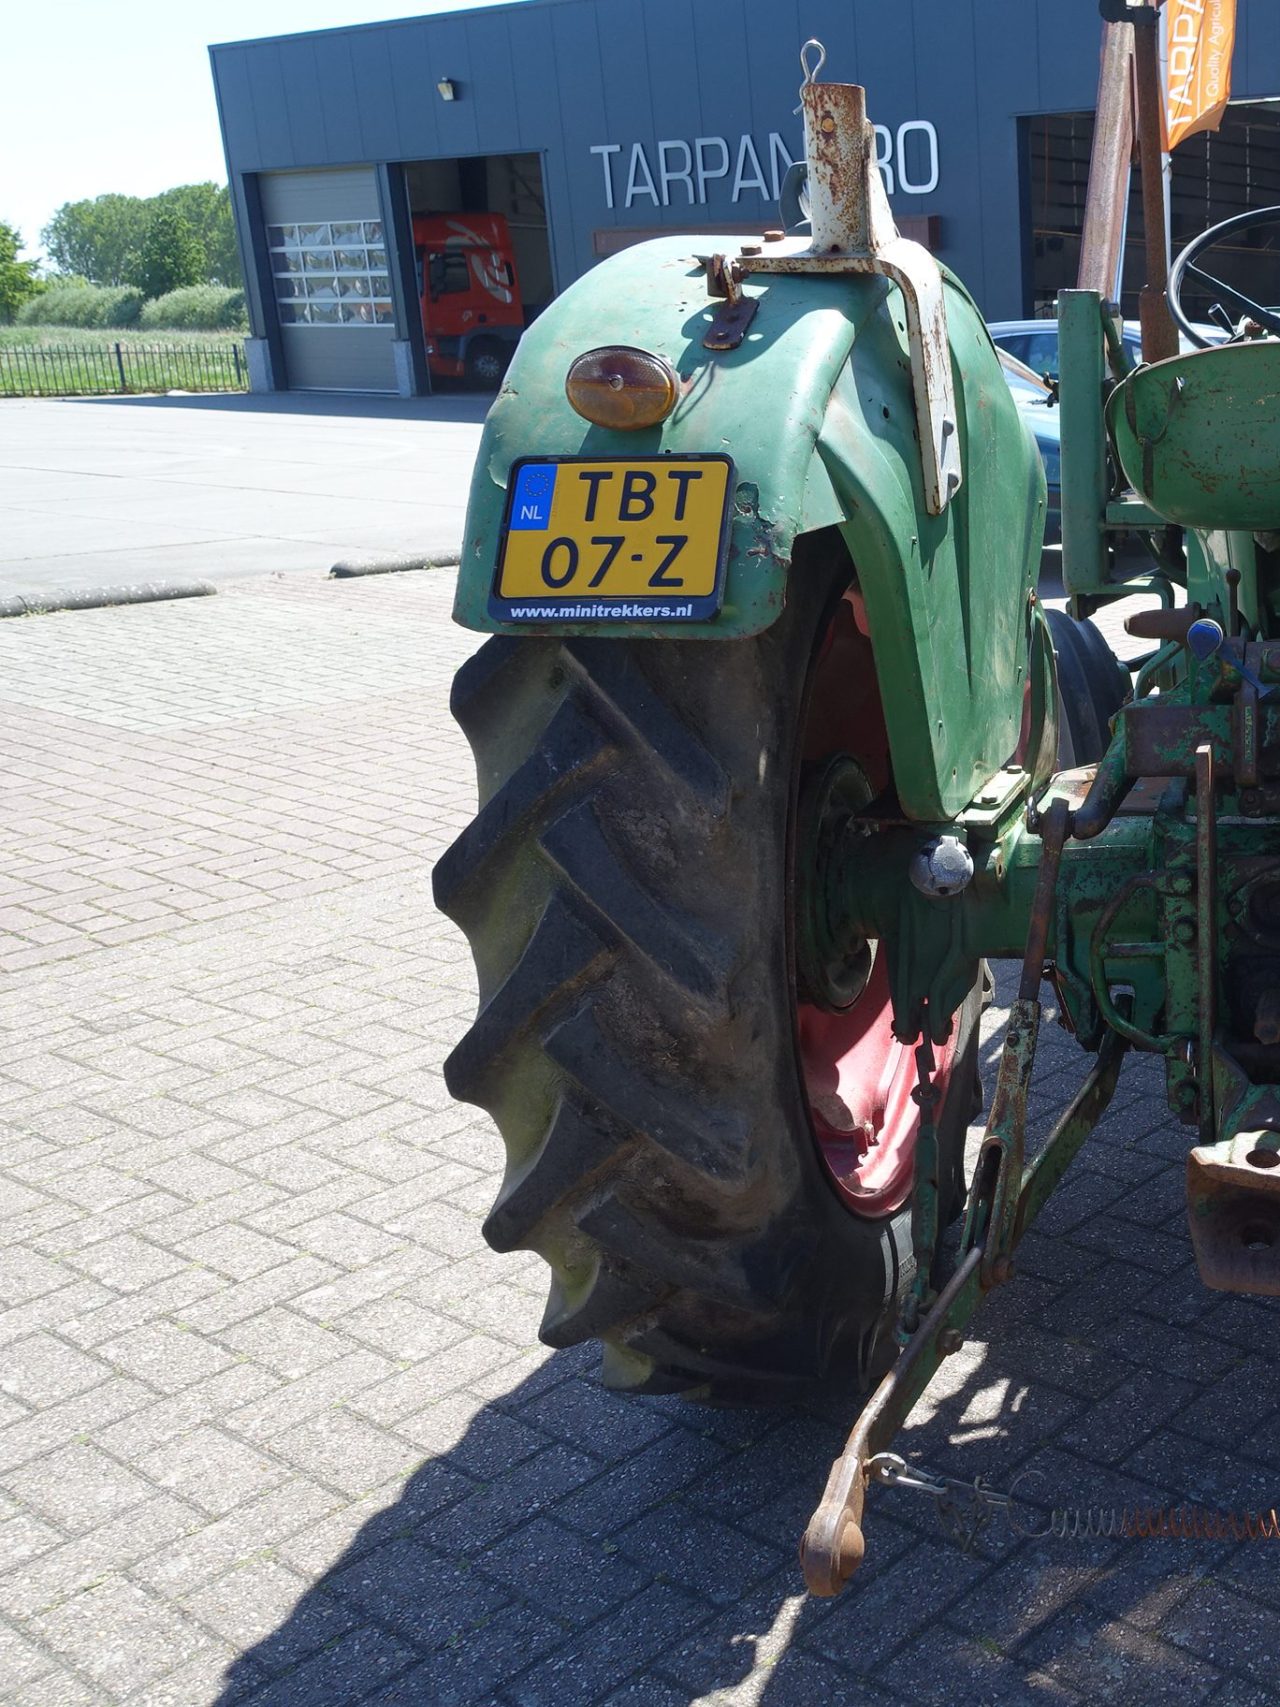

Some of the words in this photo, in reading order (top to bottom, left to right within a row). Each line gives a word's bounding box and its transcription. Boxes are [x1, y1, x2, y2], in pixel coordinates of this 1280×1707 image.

[1205, 49, 1224, 97] Quality
[520, 505, 543, 520] NL
[578, 470, 703, 522] TBT
[541, 535, 688, 589] 07-Z
[510, 604, 693, 618] www.minitrekkers.nl
